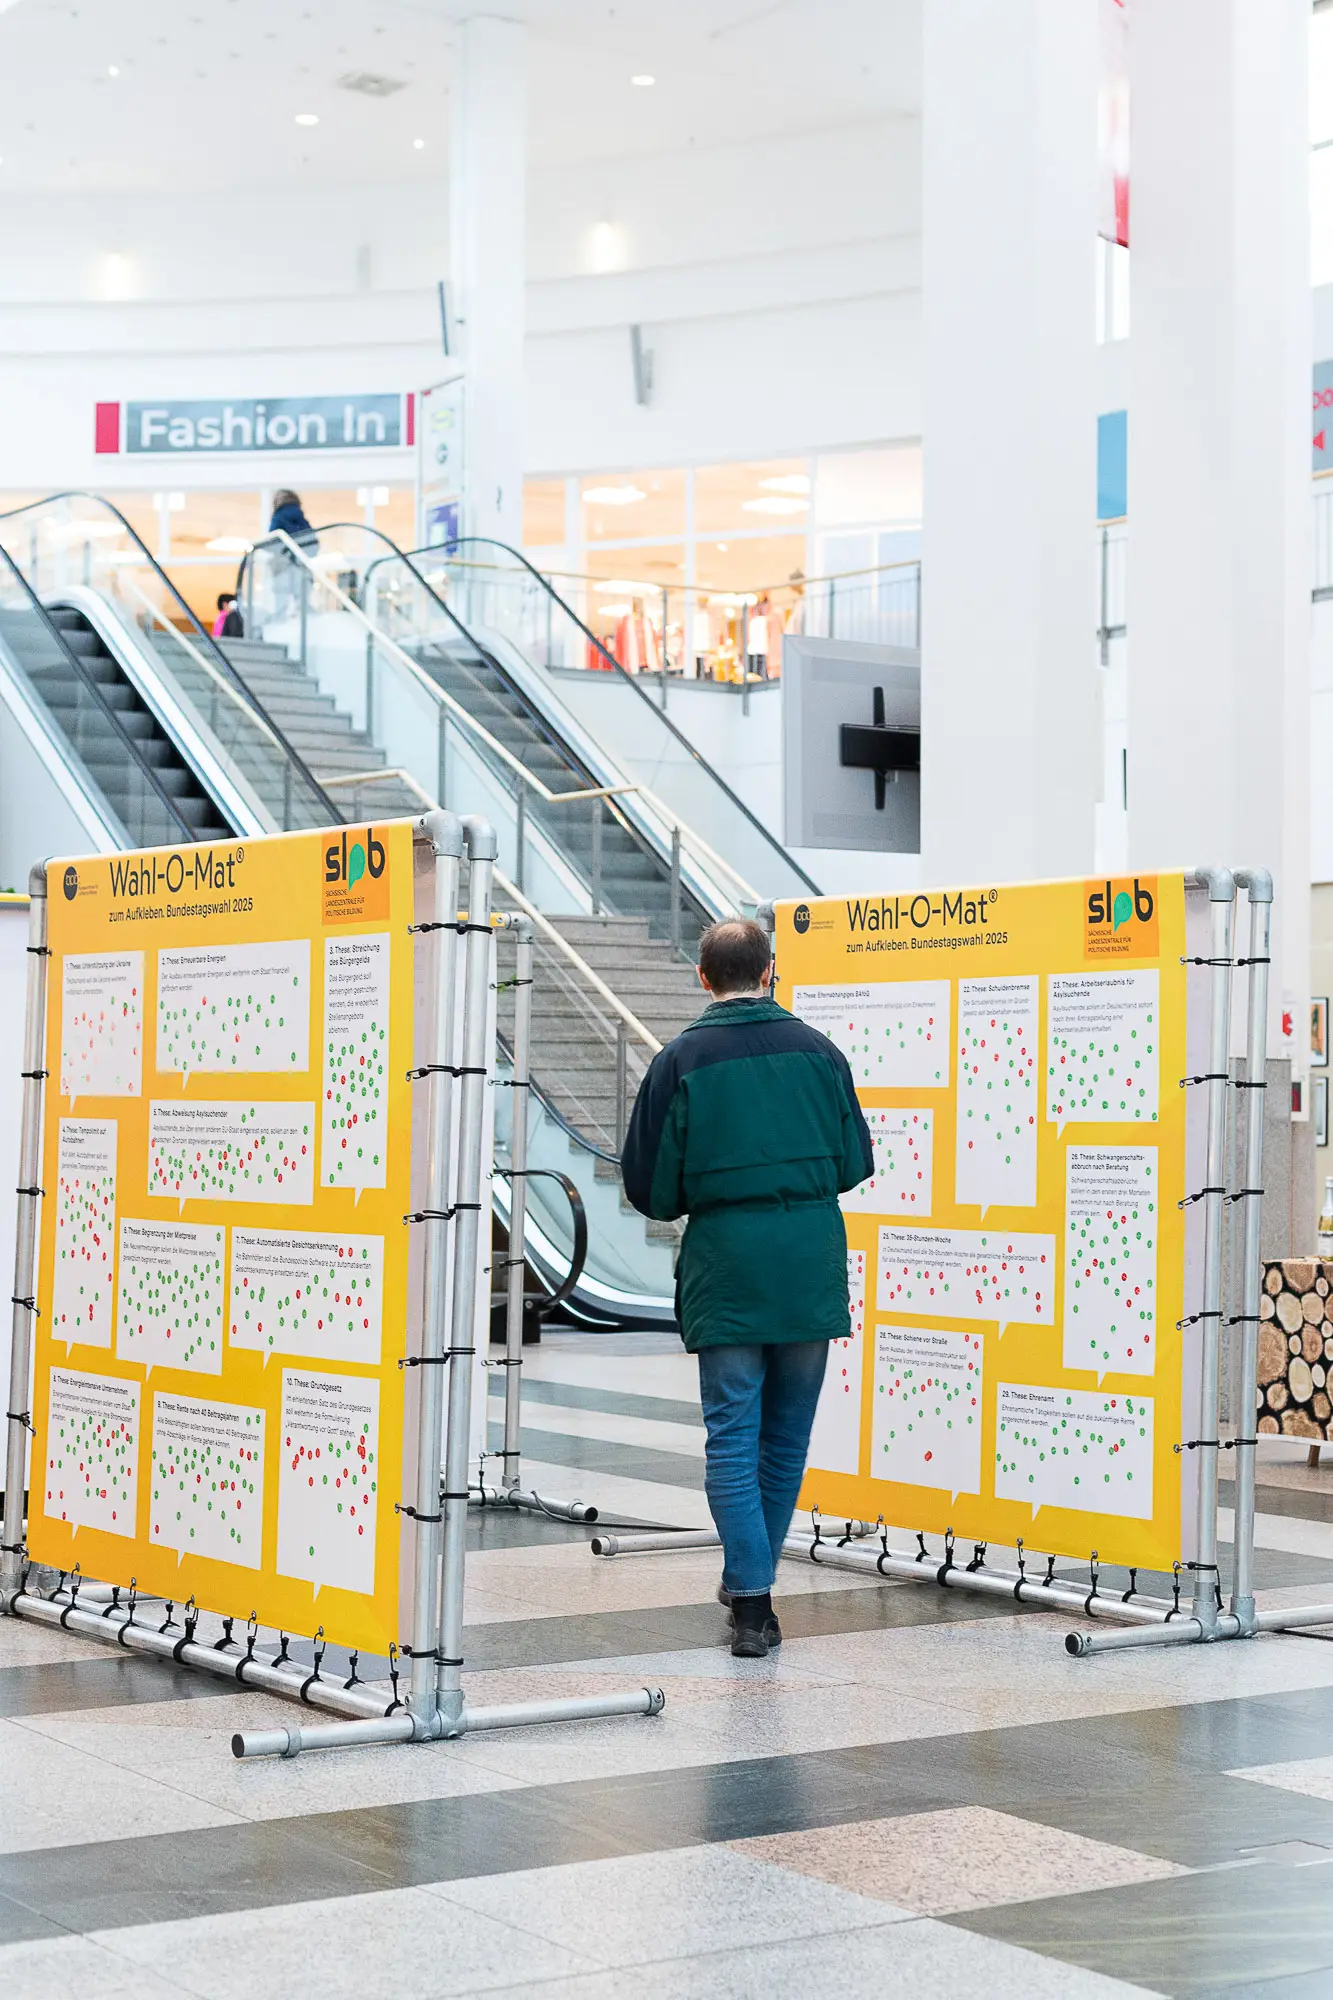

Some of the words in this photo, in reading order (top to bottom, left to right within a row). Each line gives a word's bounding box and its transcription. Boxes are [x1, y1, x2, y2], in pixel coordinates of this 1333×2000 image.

[141, 405, 326, 448] Fashion
[344, 404, 385, 443] In
[109, 912, 124, 922] zum
[126, 906, 164, 920] Aufkleben.
[166, 900, 230, 918] Bundestagswahl
[233, 898, 253, 912] 2025
[847, 944, 863, 953] zum
[865, 940, 909, 952] Aufkleben.
[911, 933, 983, 949] Bundestagswahl
[985, 932, 1008, 944] 2025
